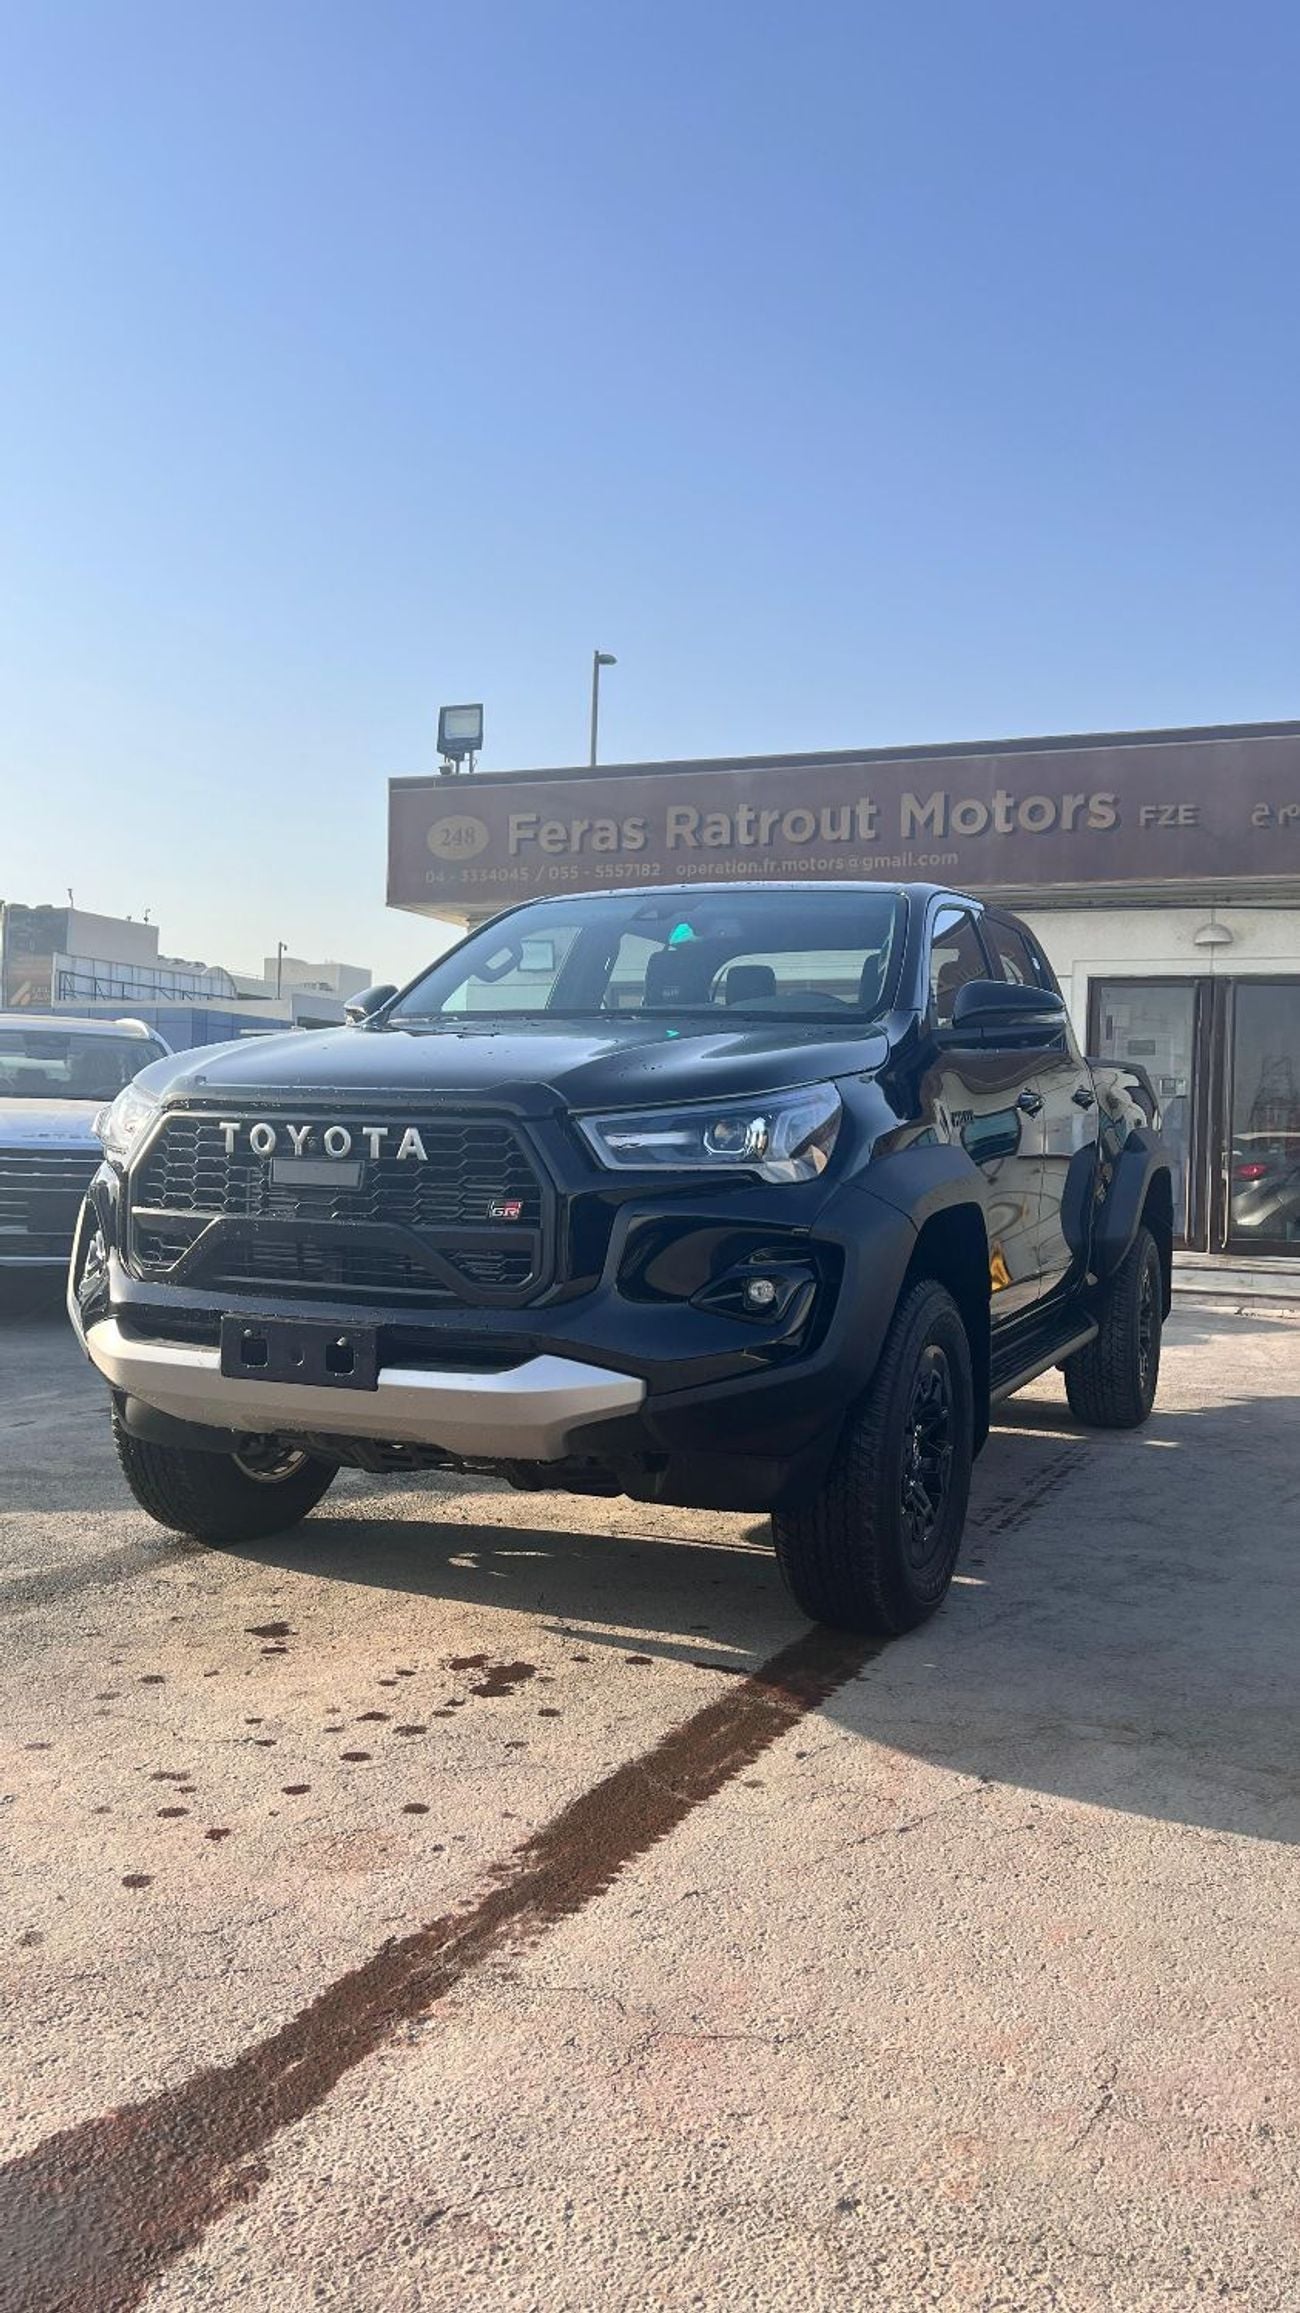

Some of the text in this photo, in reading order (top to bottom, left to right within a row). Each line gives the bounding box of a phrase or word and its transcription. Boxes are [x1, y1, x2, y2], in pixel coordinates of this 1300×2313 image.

[440, 826, 476, 846] 248
[507, 790, 1197, 855] Feras Ratrout Motors FZE
[548, 864, 579, 880] 055
[595, 861, 661, 879] 5557182
[676, 850, 959, 878] operation.fr.motors@gmail.com
[219, 1122, 428, 1161] TOYOTA
[491, 1206, 519, 1219] GR
